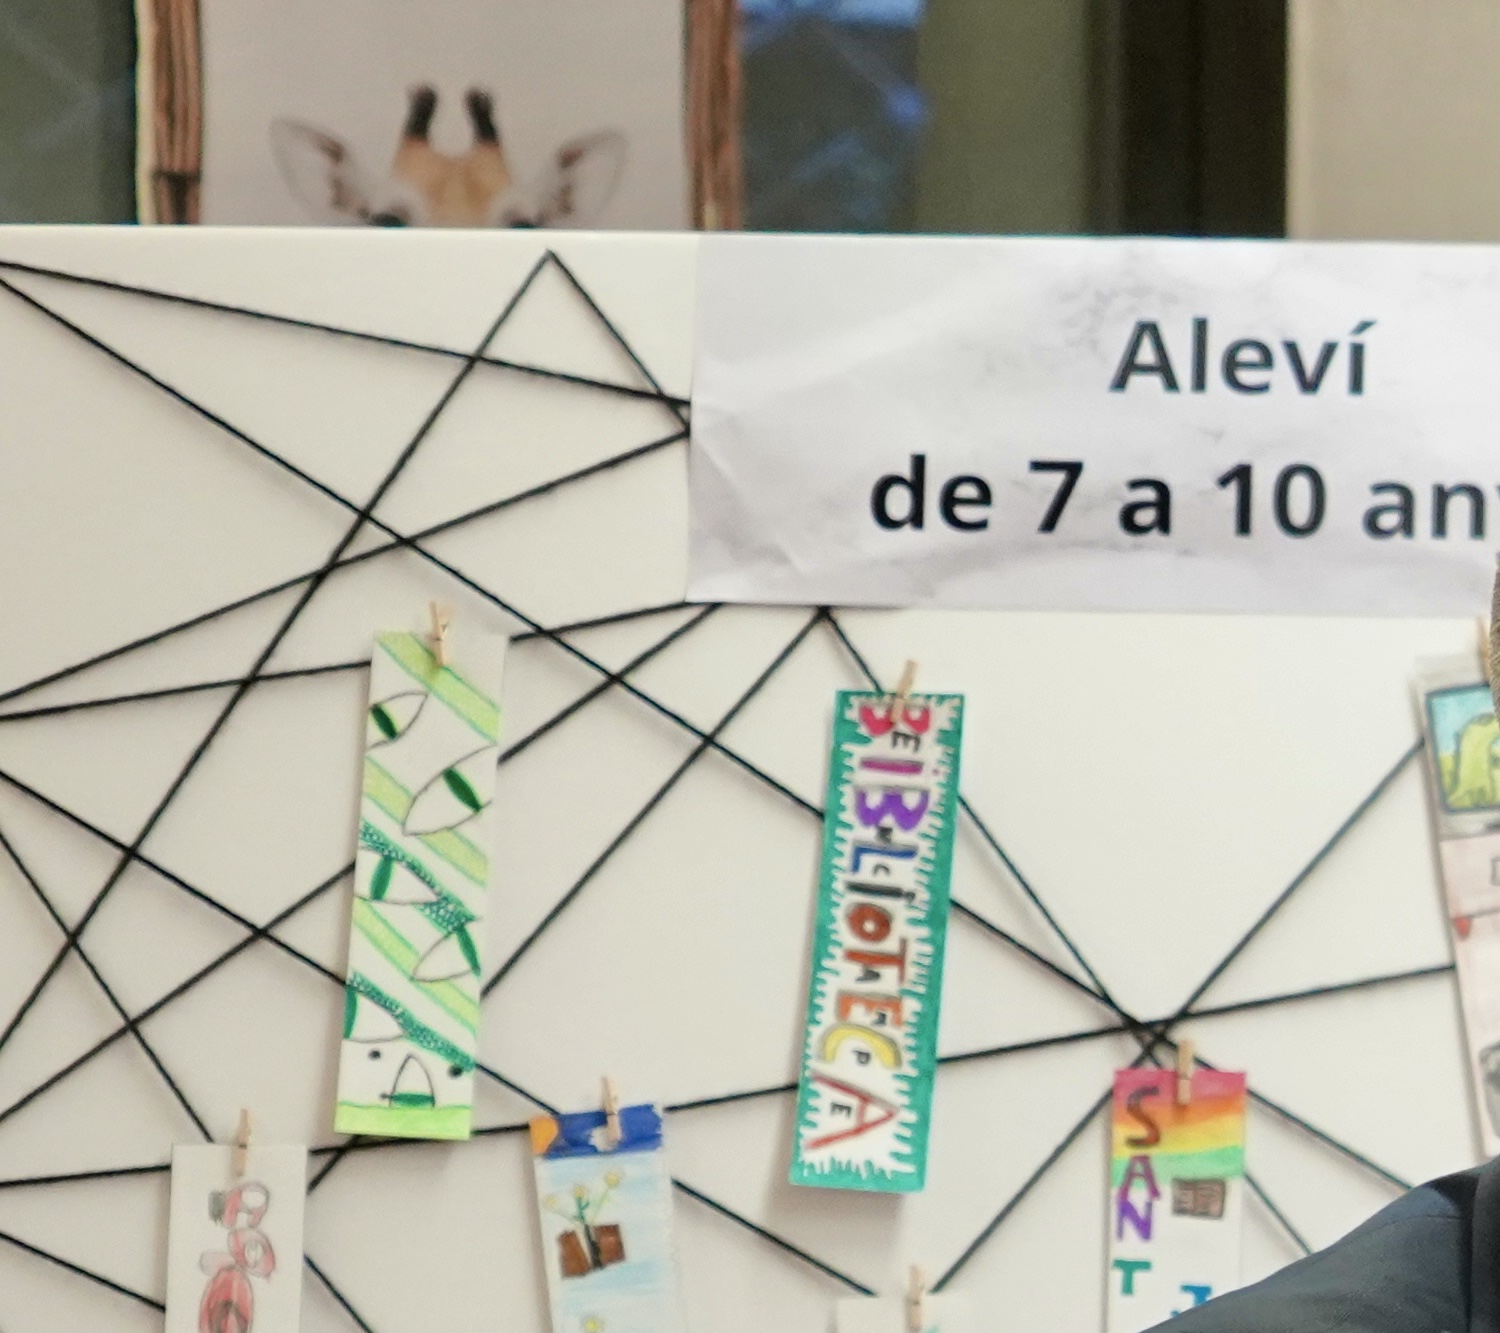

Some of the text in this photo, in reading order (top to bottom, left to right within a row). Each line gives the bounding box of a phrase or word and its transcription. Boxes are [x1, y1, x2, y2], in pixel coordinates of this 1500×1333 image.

[1109, 321, 1378, 395] Aleví
[869, 454, 992, 533] de
[1027, 460, 1085, 535] 7
[1119, 480, 1173, 537] a
[1215, 463, 1328, 537] 10
